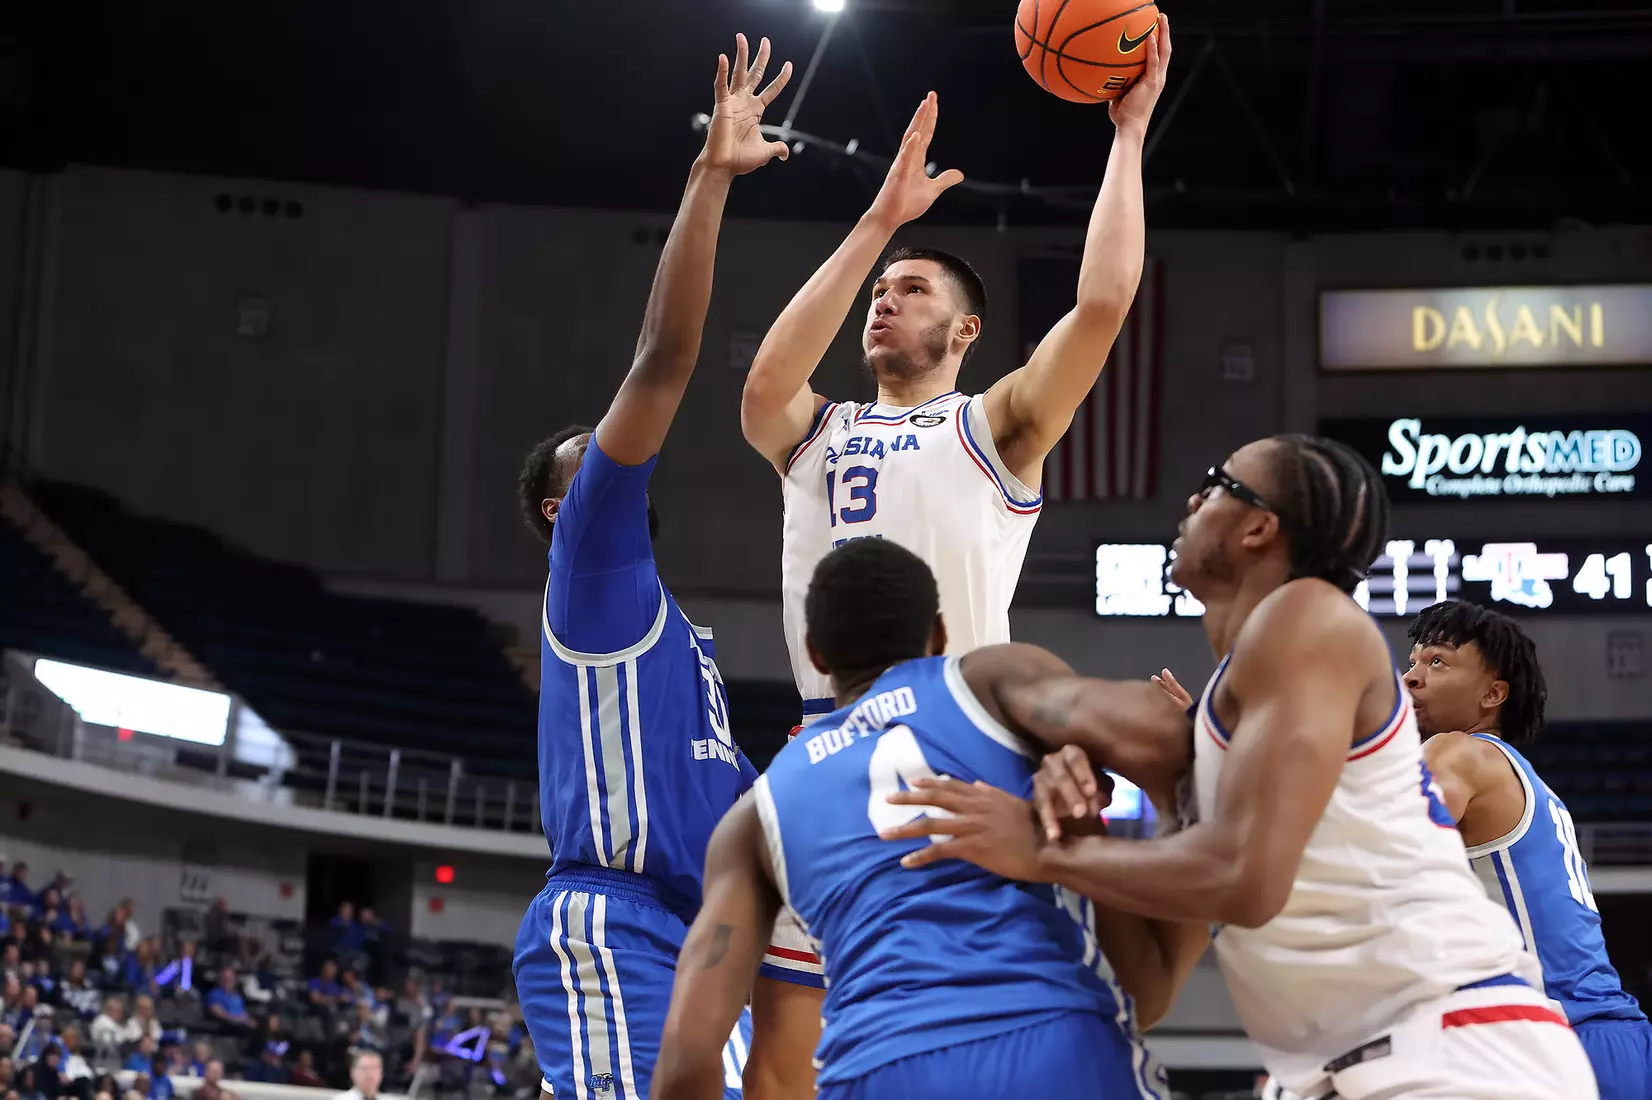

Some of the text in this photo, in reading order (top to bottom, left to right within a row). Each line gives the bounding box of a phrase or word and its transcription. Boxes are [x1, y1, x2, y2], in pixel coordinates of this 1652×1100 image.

[1412, 298, 1604, 361] DASANI
[1381, 418, 1642, 489] SportsMED
[1573, 552, 1632, 600] 41
[805, 686, 918, 765] BUFFORD
[868, 724, 957, 844] 4
